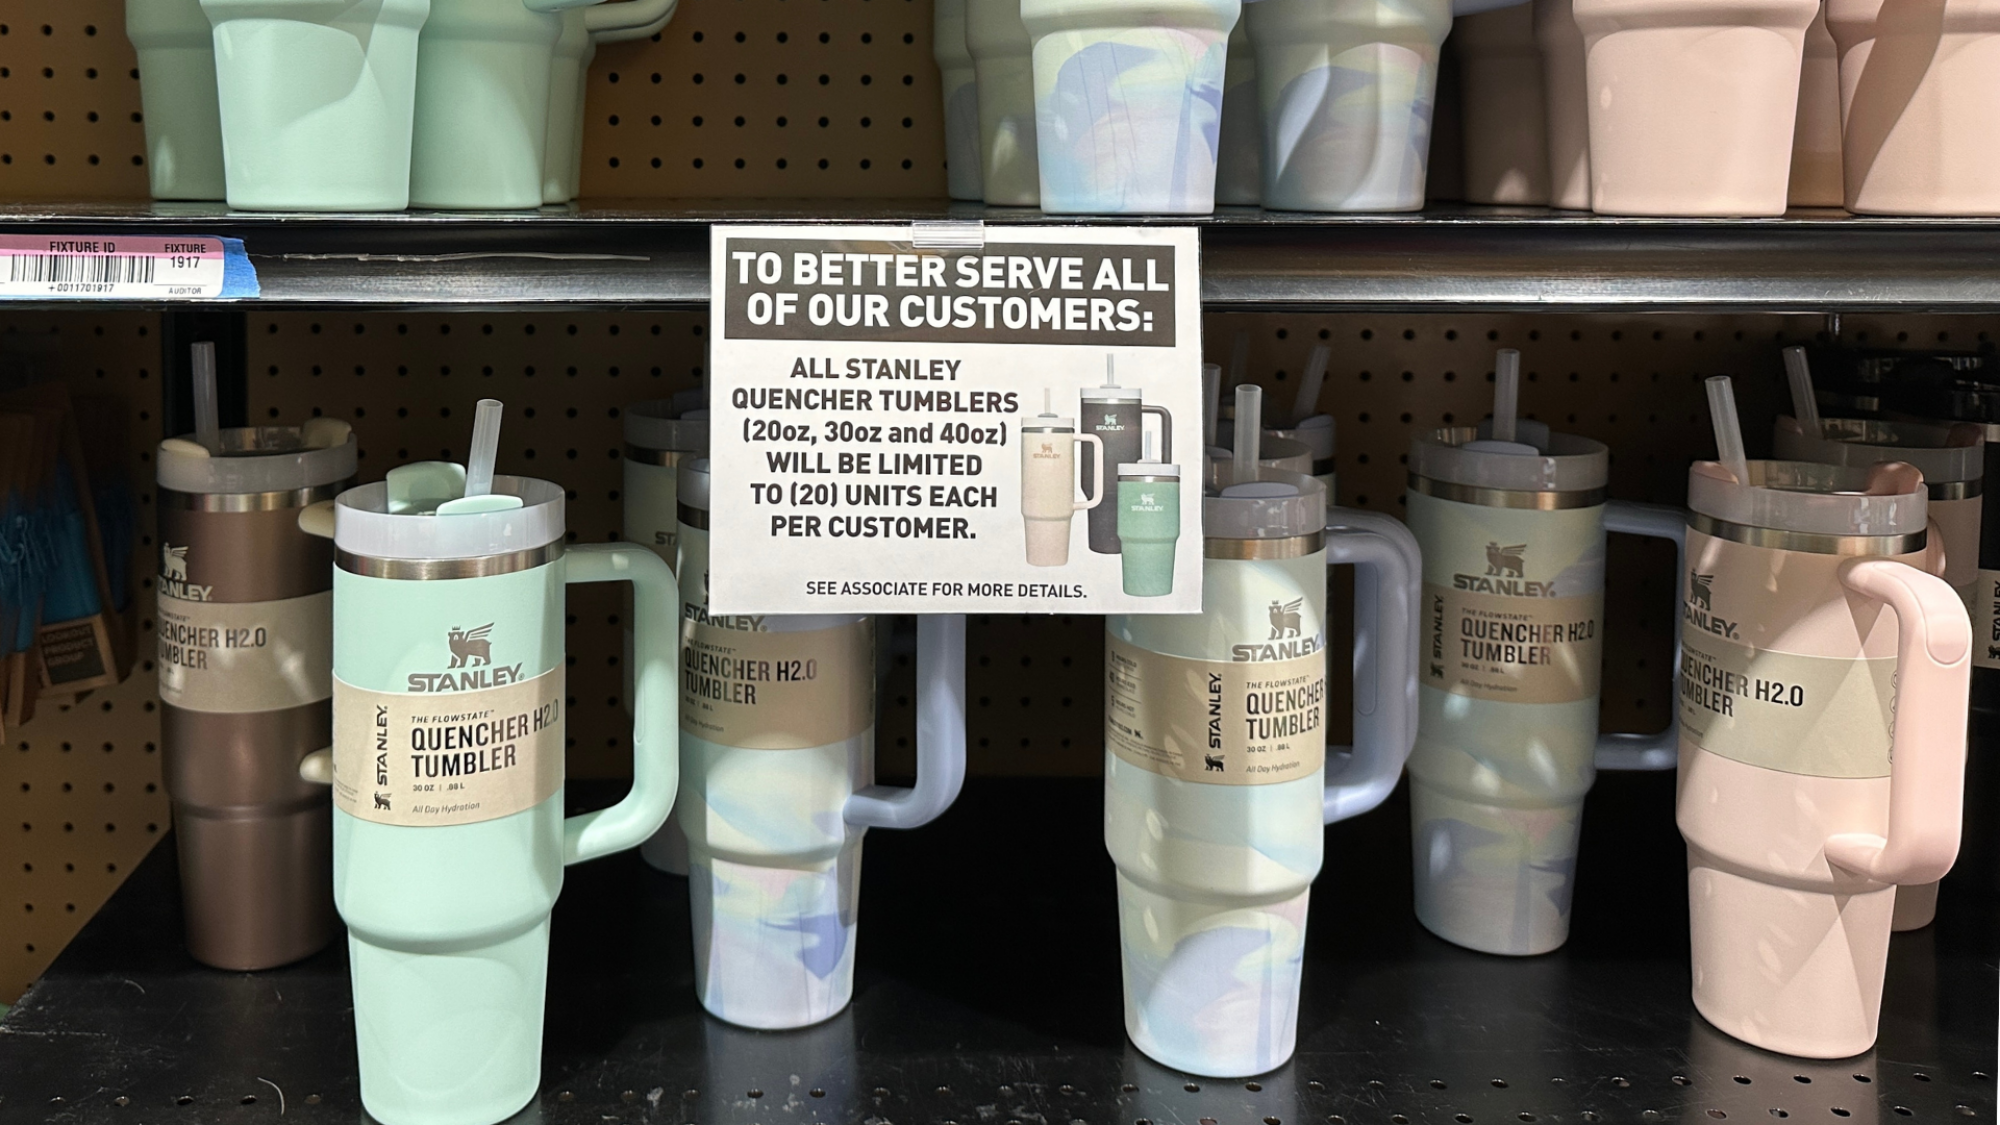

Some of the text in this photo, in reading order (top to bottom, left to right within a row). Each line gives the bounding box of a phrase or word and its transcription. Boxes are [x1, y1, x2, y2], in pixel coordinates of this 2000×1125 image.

[49, 241, 116, 254] FIXTURE ID
[164, 243, 207, 254] FIXTURE
[170, 255, 201, 269] 1917
[732, 251, 1170, 292] TO BETTER SERVE ALL
[168, 287, 202, 295] AUDITOR
[747, 293, 1153, 333] OF OUR CUSTOMERS:
[790, 356, 962, 381] ALL STANLEY
[732, 387, 1019, 414] QUENCHER TUMBLERS
[742, 416, 1008, 447] (20oz, 30oz and 40oz)
[766, 451, 983, 476] WILL BE LIMITED
[750, 481, 998, 508] TO (20) UNITS EACH
[1130, 504, 1164, 512] STANLEY
[770, 515, 977, 539] PER CUSTOMER.
[806, 581, 1088, 599] SEE ASSOCIATE FOR MORE DETAILS.
[1453, 572, 1556, 598] STANLEY
[1461, 607, 1476, 617] THE
[225, 626, 267, 649] H2.0
[1433, 594, 1445, 660] STANLEY
[1461, 617, 1595, 644] QUENCHER H2.0
[159, 644, 208, 670] MBLER
[1231, 634, 1320, 662] STANLEY
[1460, 638, 1551, 666] TUMBLER
[407, 661, 523, 693] STANLEY
[684, 645, 818, 683] QUENCHER H2.0
[684, 669, 757, 706] TUMBLER
[1246, 676, 1307, 690] THE FLOWSTATE
[1755, 678, 1804, 707] H2.0
[1208, 672, 1222, 749] STANLEY
[1246, 679, 1324, 716] QUENCHER
[411, 711, 490, 724] THE FLOWSTATE
[411, 698, 559, 751] QUENCHER H2.0
[1246, 705, 1320, 741] TUMBLER
[376, 704, 388, 787] STANLEY
[411, 743, 517, 778] TUMBLER
[1257, 764, 1271, 775] Day
[1271, 760, 1300, 773] Hydration
[424, 783, 435, 792] OZ
[412, 801, 481, 815] All Day Hydration
